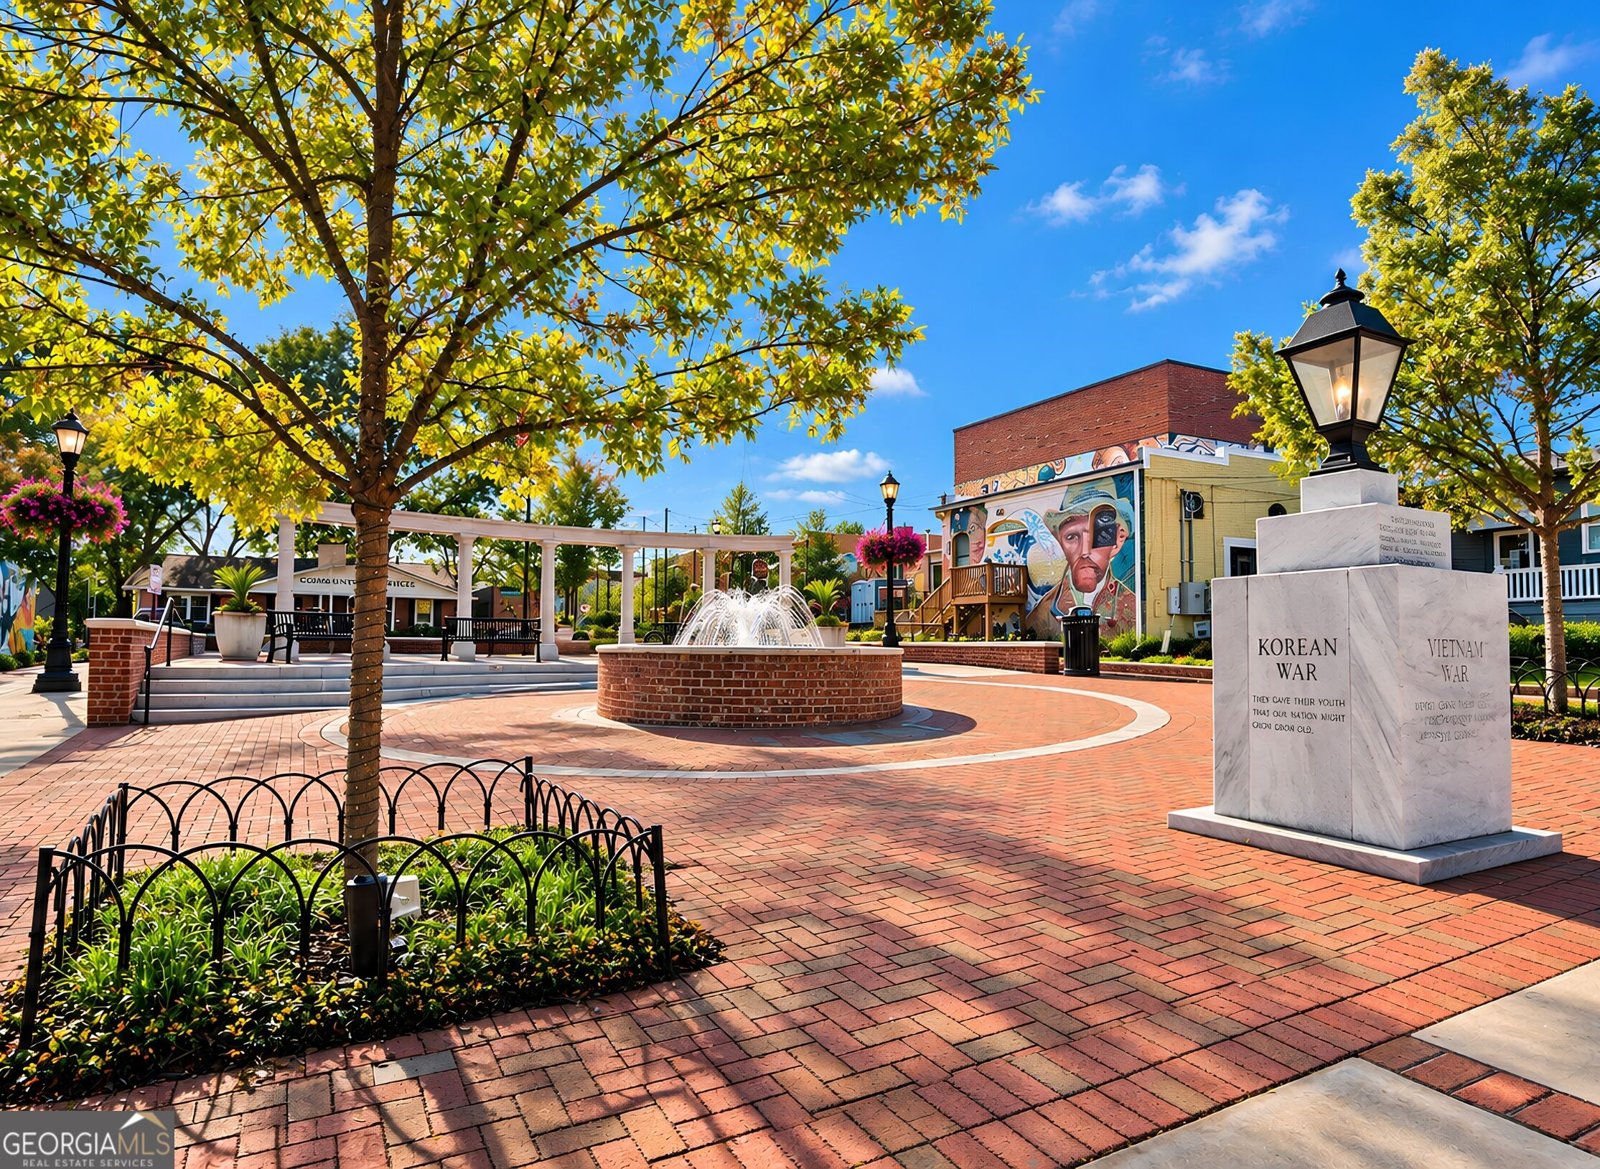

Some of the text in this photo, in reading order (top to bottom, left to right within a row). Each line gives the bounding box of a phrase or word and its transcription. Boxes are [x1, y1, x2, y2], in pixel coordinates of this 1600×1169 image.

[1258, 637, 1338, 656] KOREAN
[1427, 638, 1483, 658] VIETNAM
[1276, 662, 1318, 681] WAR
[1441, 664, 1469, 683] WAR
[1318, 698, 1346, 707] YOUTH
